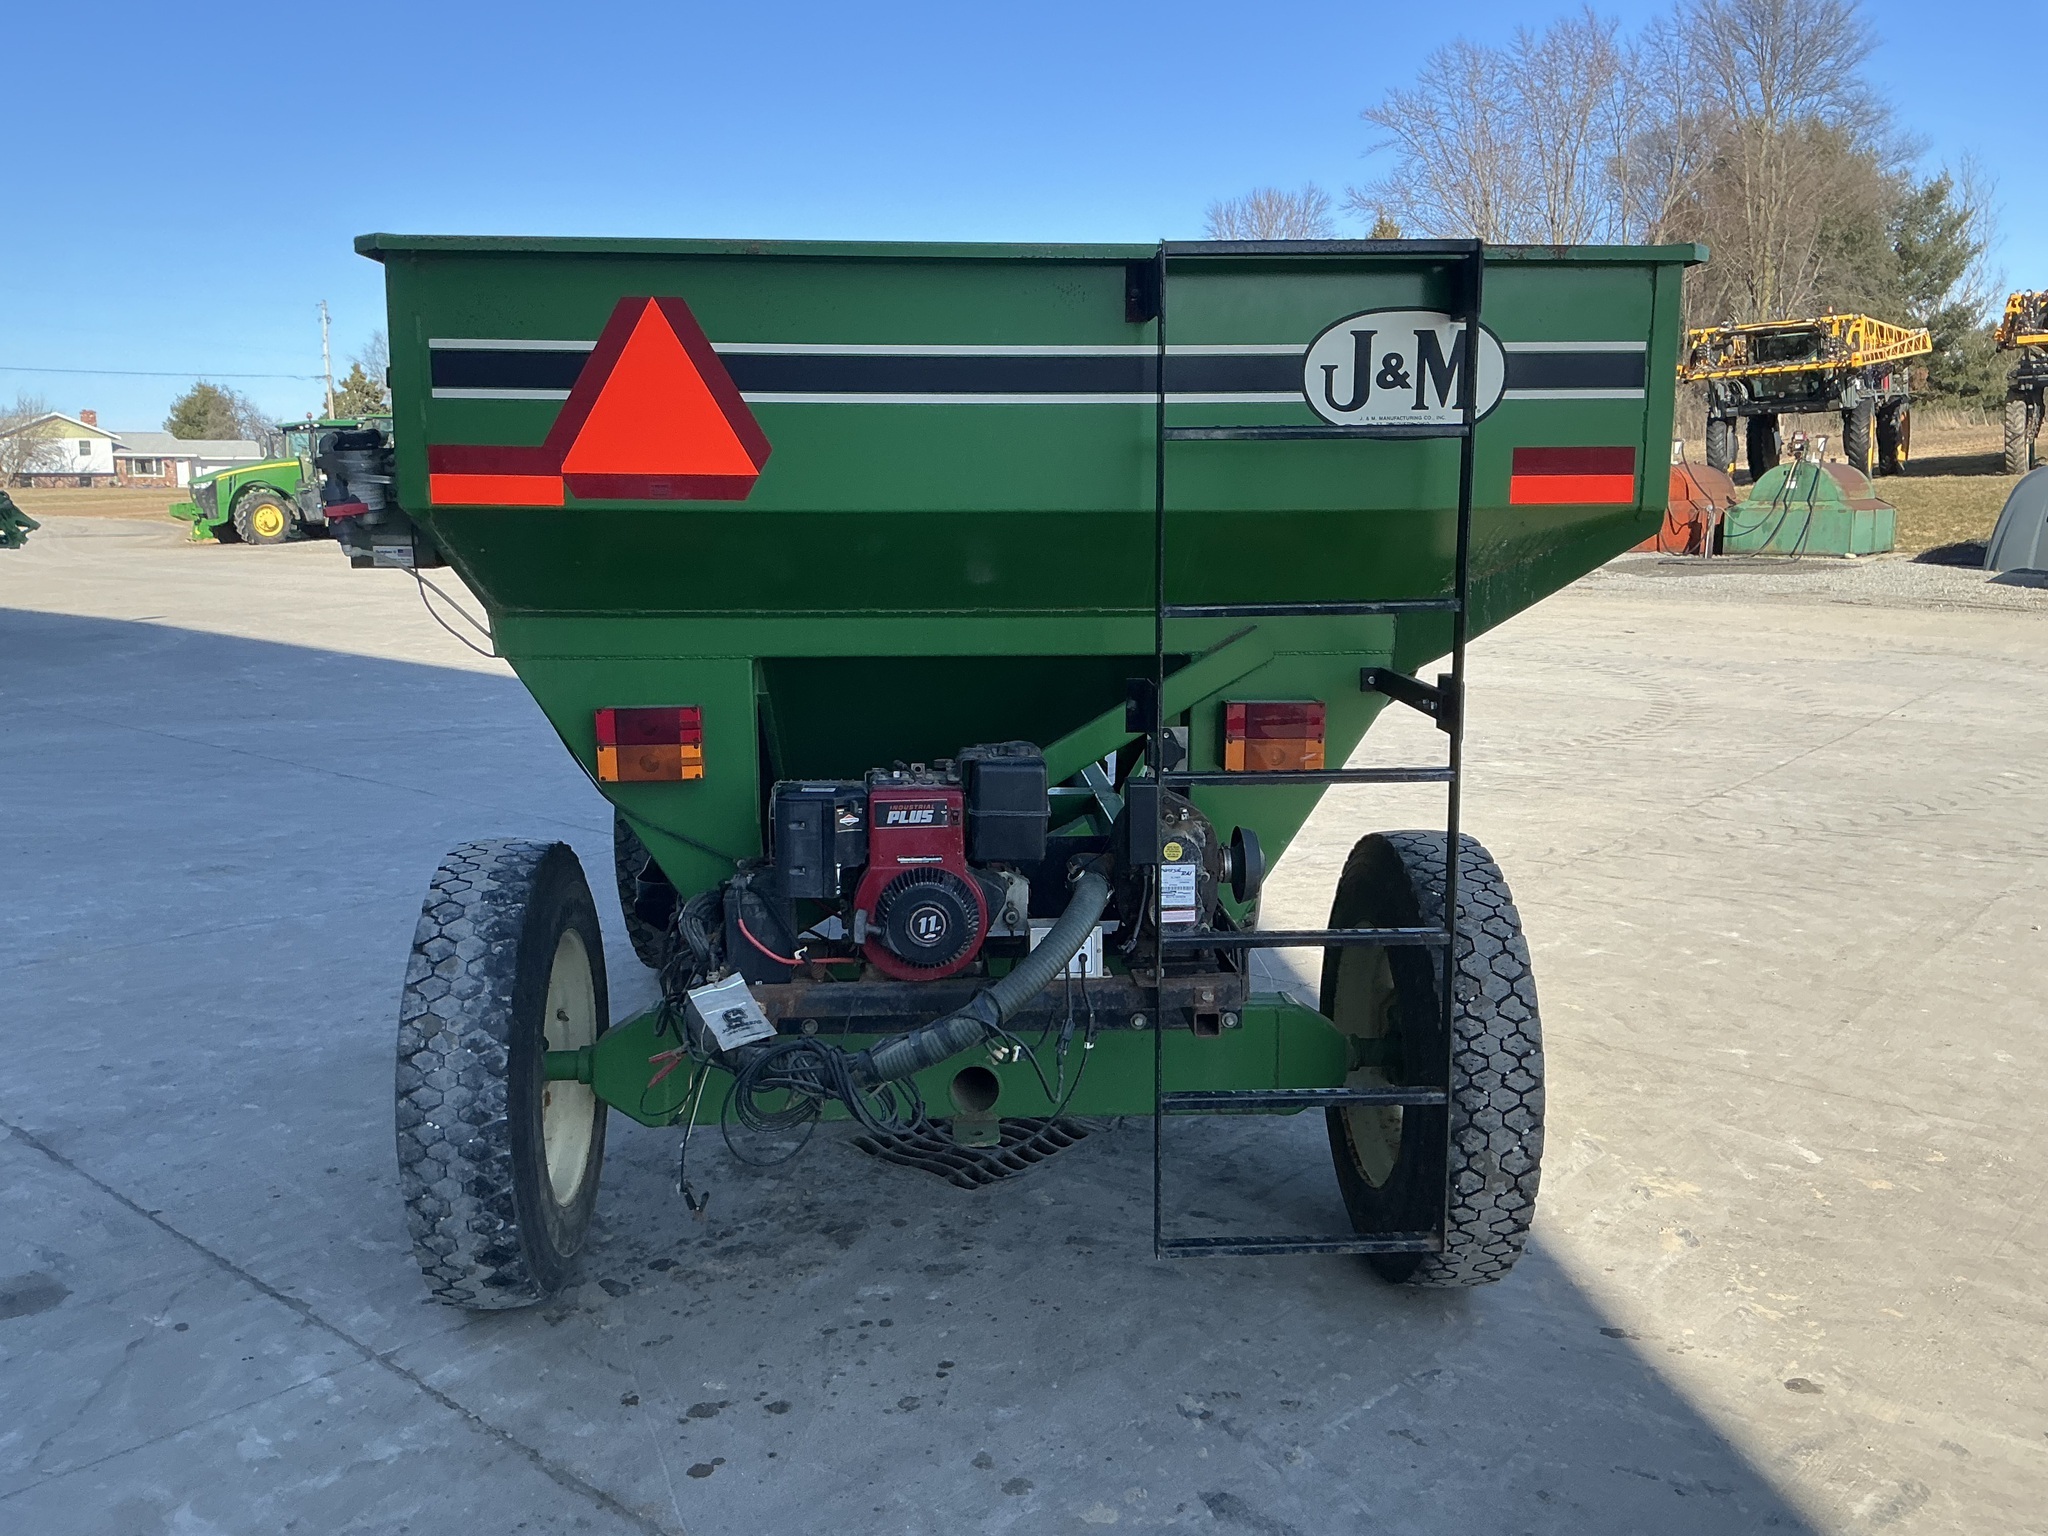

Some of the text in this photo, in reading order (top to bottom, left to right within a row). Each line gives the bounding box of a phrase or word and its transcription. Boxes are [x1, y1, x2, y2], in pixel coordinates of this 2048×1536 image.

[1320, 330, 1478, 412] J&M
[887, 810, 934, 824] PLUS
[918, 915, 937, 934] 11
